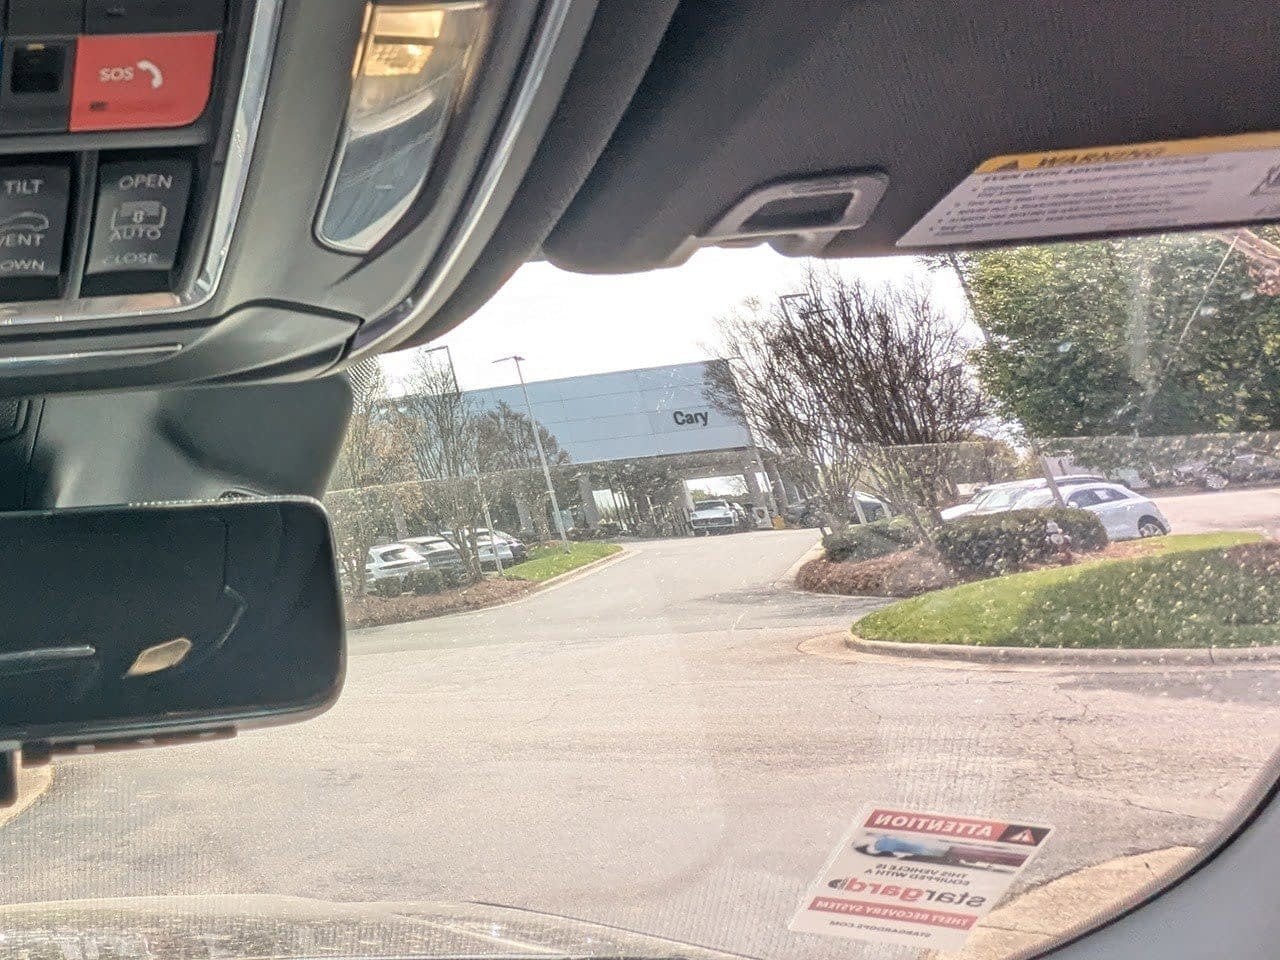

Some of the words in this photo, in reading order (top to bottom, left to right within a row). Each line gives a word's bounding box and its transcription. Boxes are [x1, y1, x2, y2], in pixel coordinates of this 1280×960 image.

[99, 66, 135, 83] SOS
[4, 178, 44, 195] TILT
[119, 173, 173, 190] OPEN
[111, 226, 162, 241] AUTO
[103, 251, 158, 265] CLOSE
[672, 410, 709, 427] Cary
